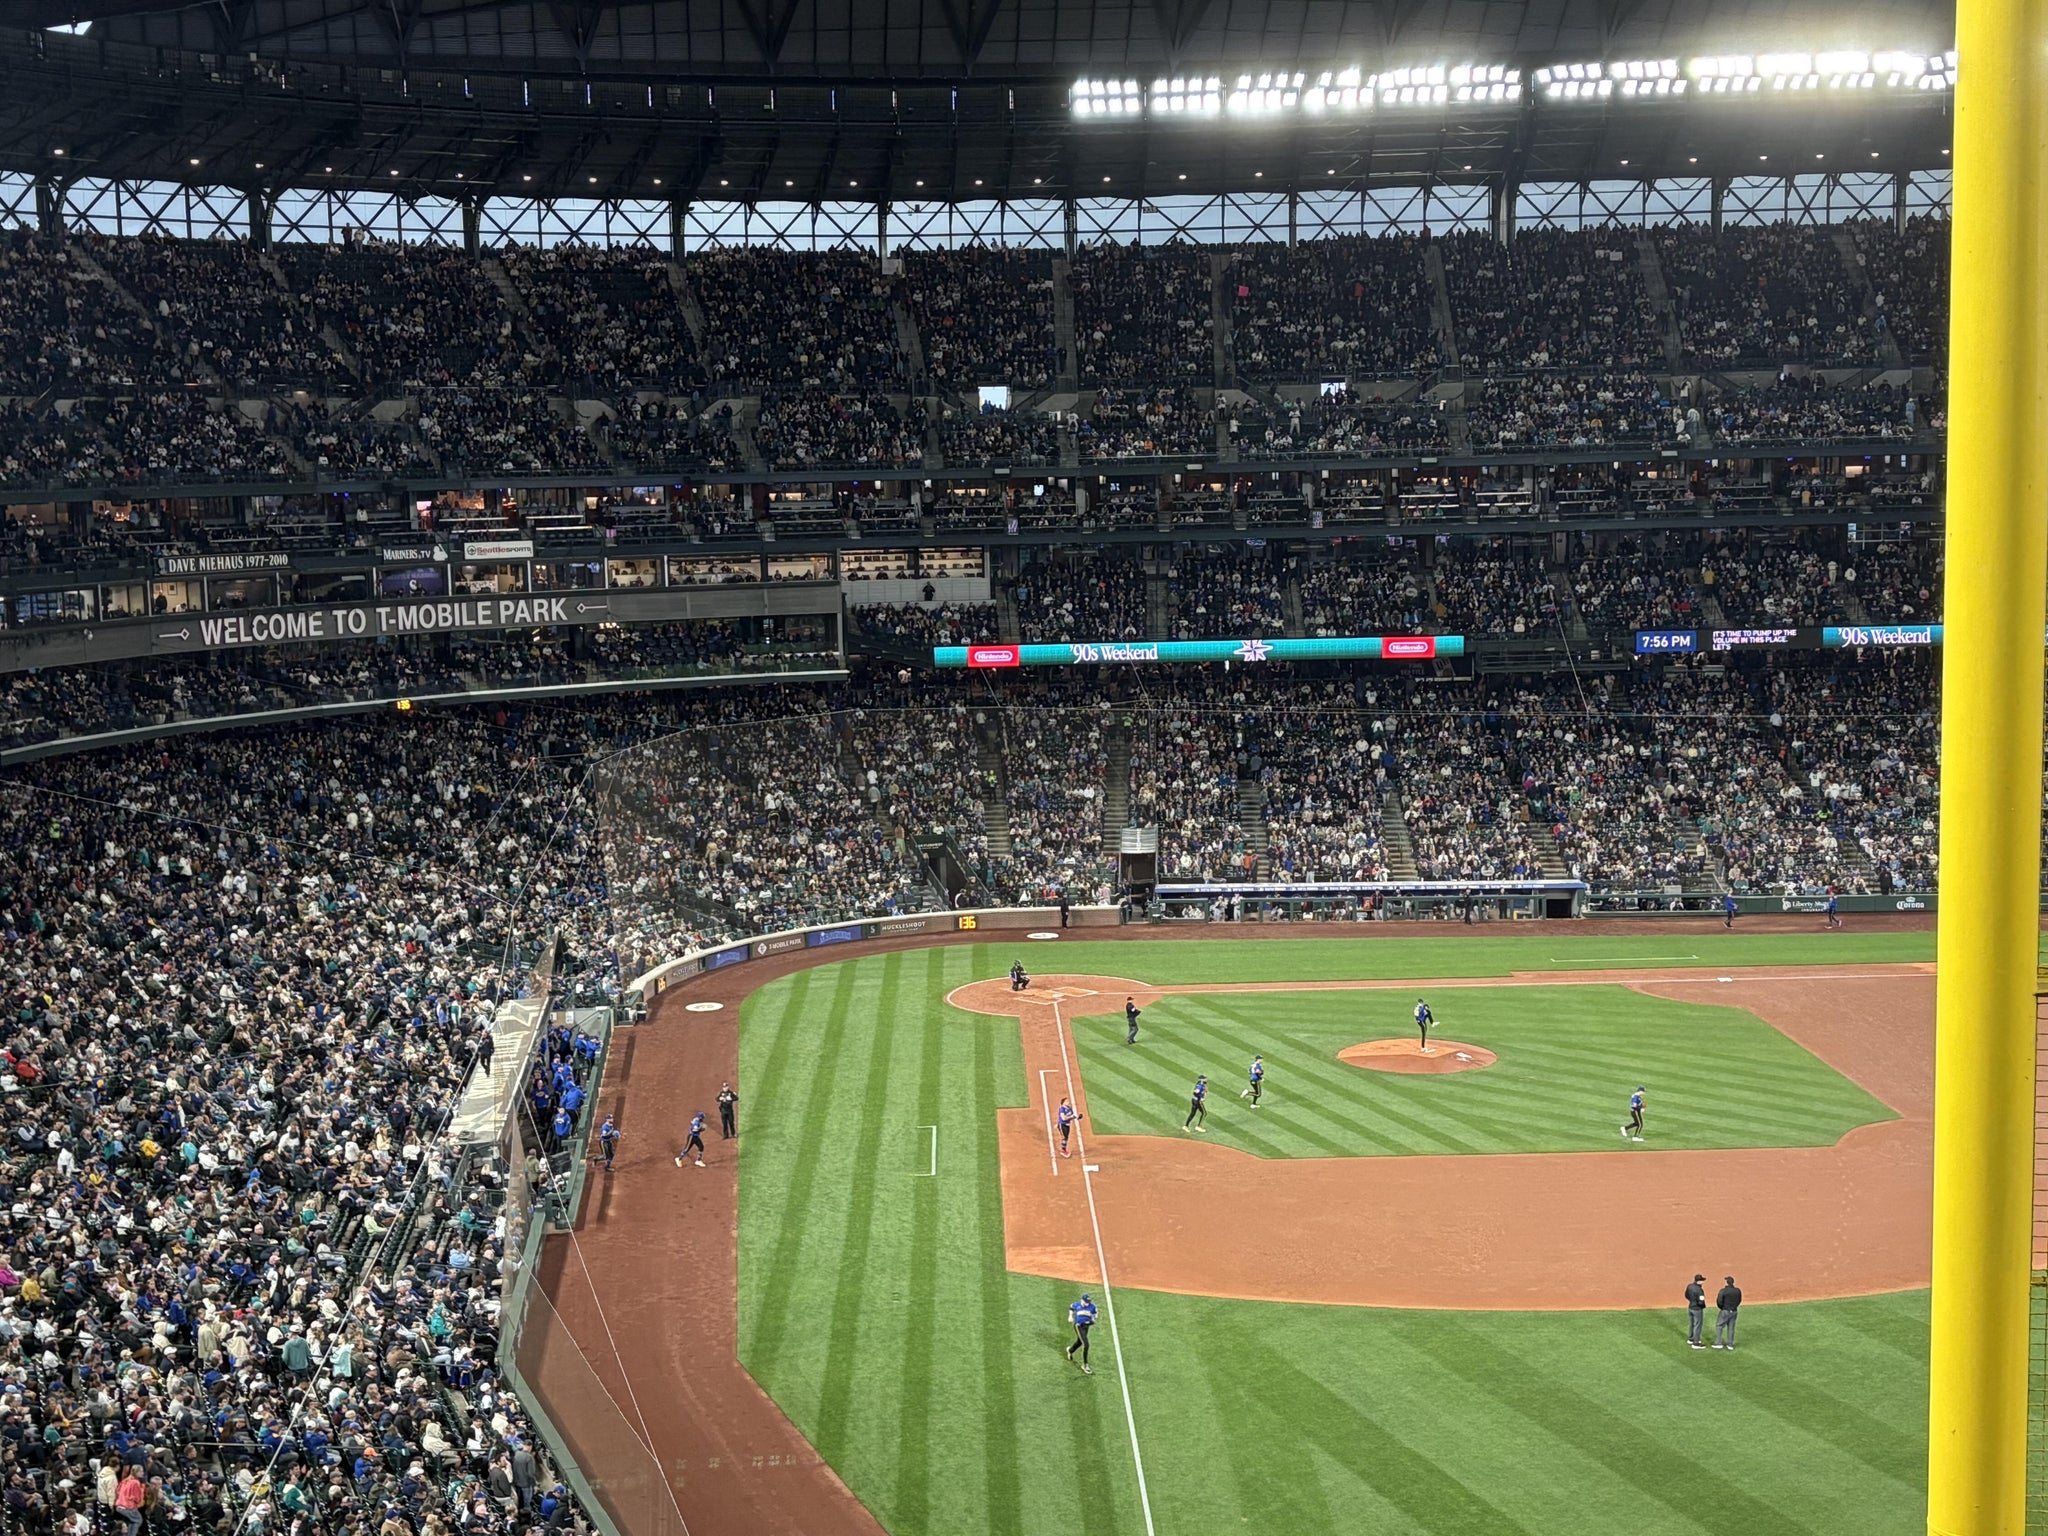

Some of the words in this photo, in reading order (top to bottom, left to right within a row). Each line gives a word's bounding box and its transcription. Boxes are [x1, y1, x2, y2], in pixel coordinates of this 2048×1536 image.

[168, 558, 196, 573] DAVE
[199, 555, 244, 571] NIEHAUS
[245, 554, 288, 567] 1977-2010
[200, 611, 324, 645] WELCOME
[332, 608, 367, 634] TO
[376, 602, 493, 632] T-MOBILE
[500, 597, 568, 624] PARK
[1753, 629, 1772, 637] PUMP
[1838, 627, 1868, 648] '90s
[1870, 627, 1931, 645] Weekend
[1391, 643, 1426, 651] Nintendo
[1642, 635, 1669, 648] 7:56
[1671, 635, 1691, 647] PM
[977, 652, 1011, 660] Nintendo
[1069, 644, 1098, 664] '90s
[1100, 643, 1158, 661] Weekend
[1896, 900, 1925, 910] Corona
